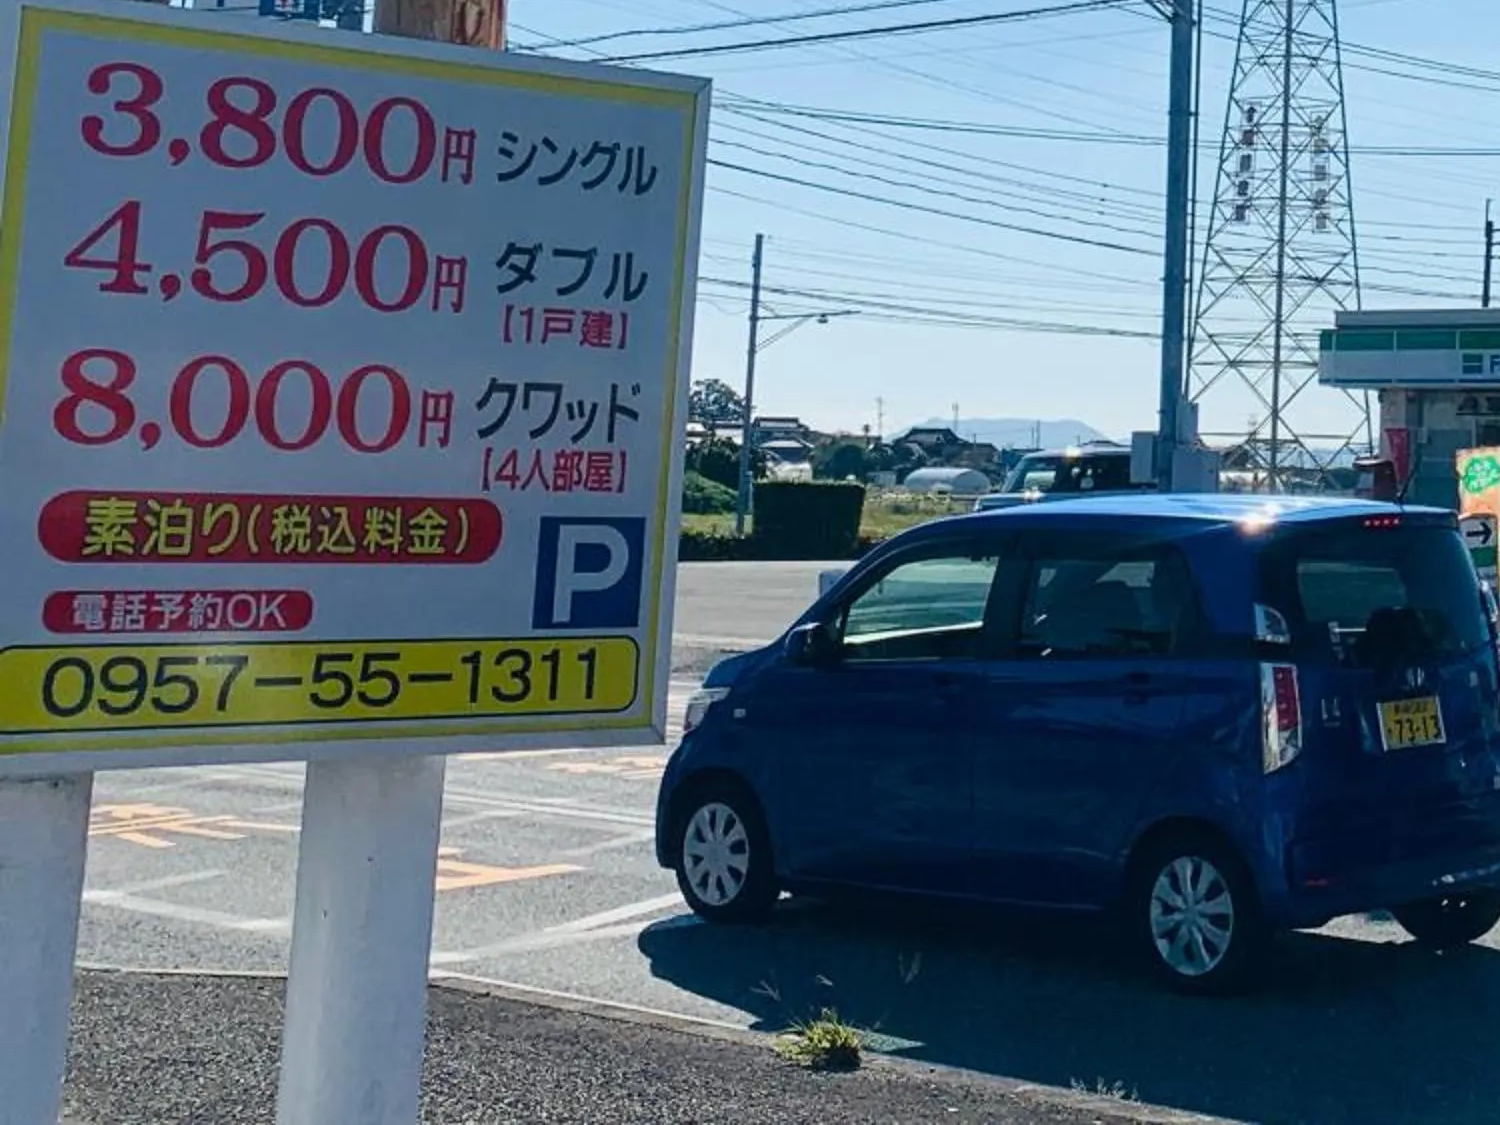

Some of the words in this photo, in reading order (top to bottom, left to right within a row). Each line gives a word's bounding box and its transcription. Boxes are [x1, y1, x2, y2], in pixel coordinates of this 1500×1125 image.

[81, 62, 477, 185] 3,800円
[497, 131, 657, 195] シングル
[64, 200, 467, 313] 4,500円
[53, 348, 453, 453] 8,000円
[476, 377, 641, 444] クワッド
[72, 593, 287, 631] 電話予約OK
[552, 524, 630, 623] P
[42, 648, 598, 717] 0957-55-1311
